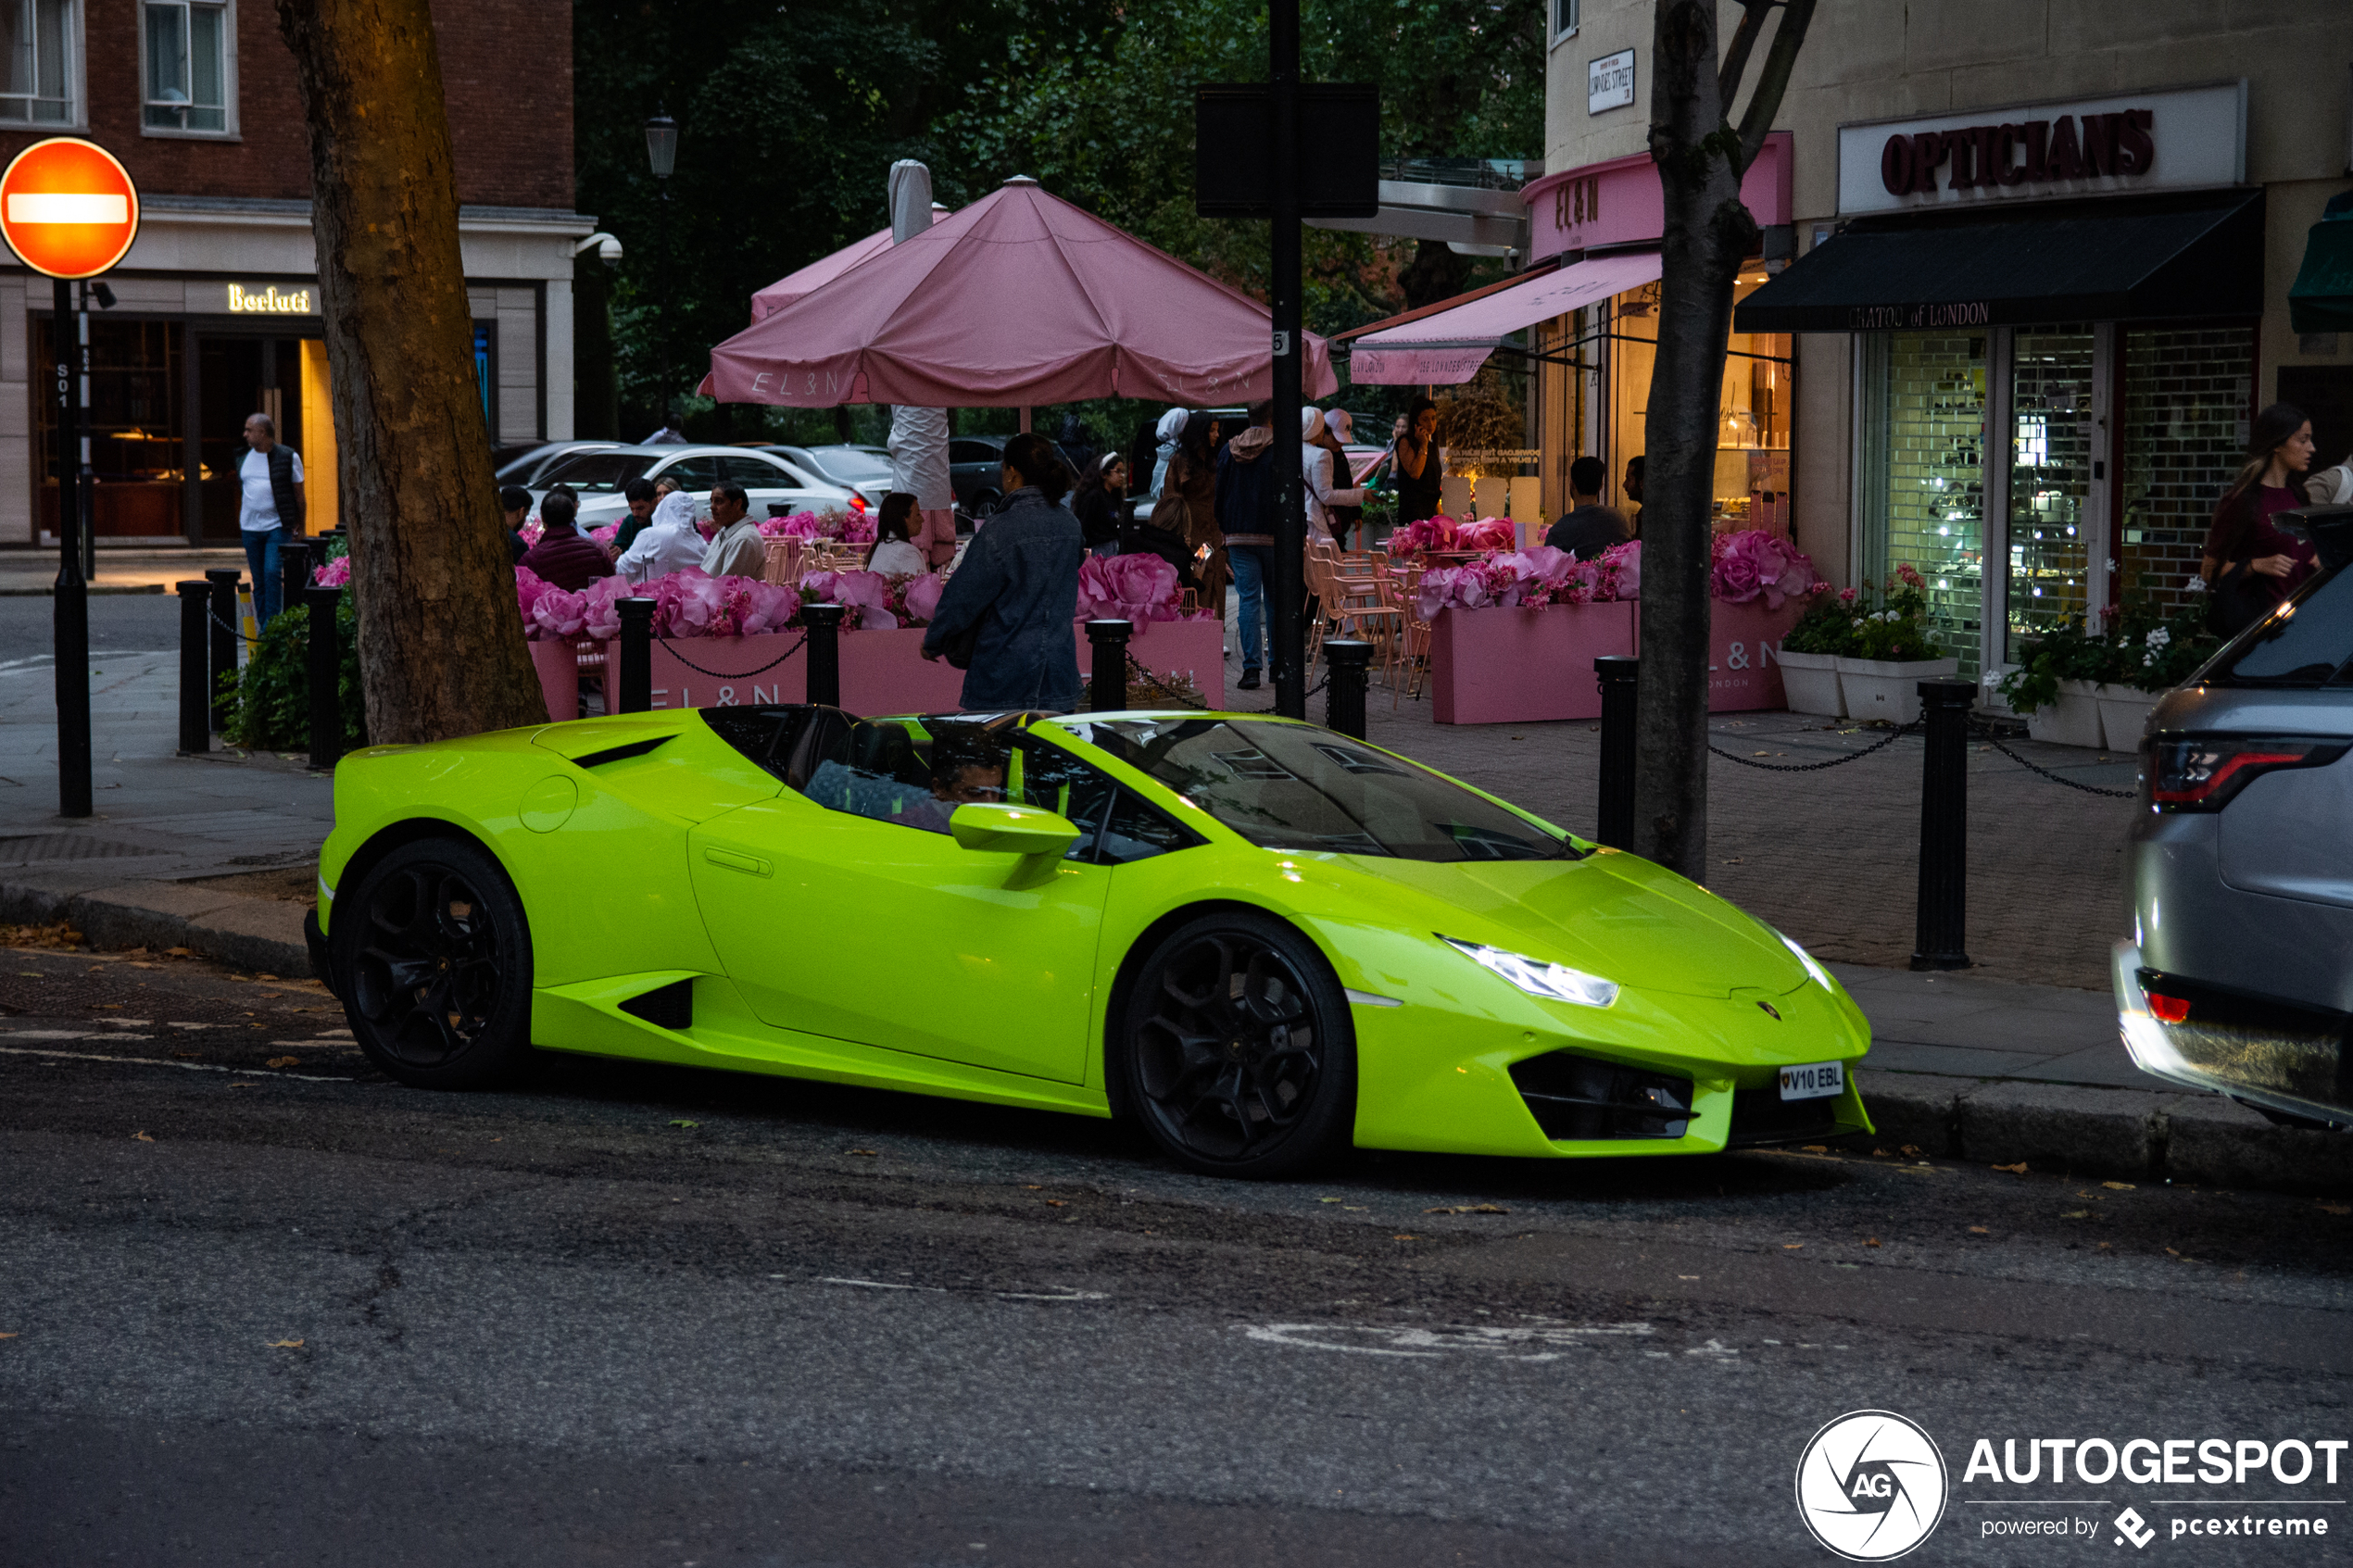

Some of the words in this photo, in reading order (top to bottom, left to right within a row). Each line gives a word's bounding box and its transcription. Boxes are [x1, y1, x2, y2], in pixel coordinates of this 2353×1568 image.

[1590, 72, 1611, 96] LOWNDES
[1612, 66, 1632, 89] STREET
[1881, 109, 2154, 195] OPTICIANS
[228, 283, 311, 313] Berluti
[1849, 307, 1904, 330] CHATOO
[1910, 305, 1925, 327] of
[1930, 302, 1990, 327] LONDON
[1708, 679, 1748, 689] ONDON
[1791, 1070, 1815, 1090] V10
[1818, 1067, 1841, 1087] EBL
